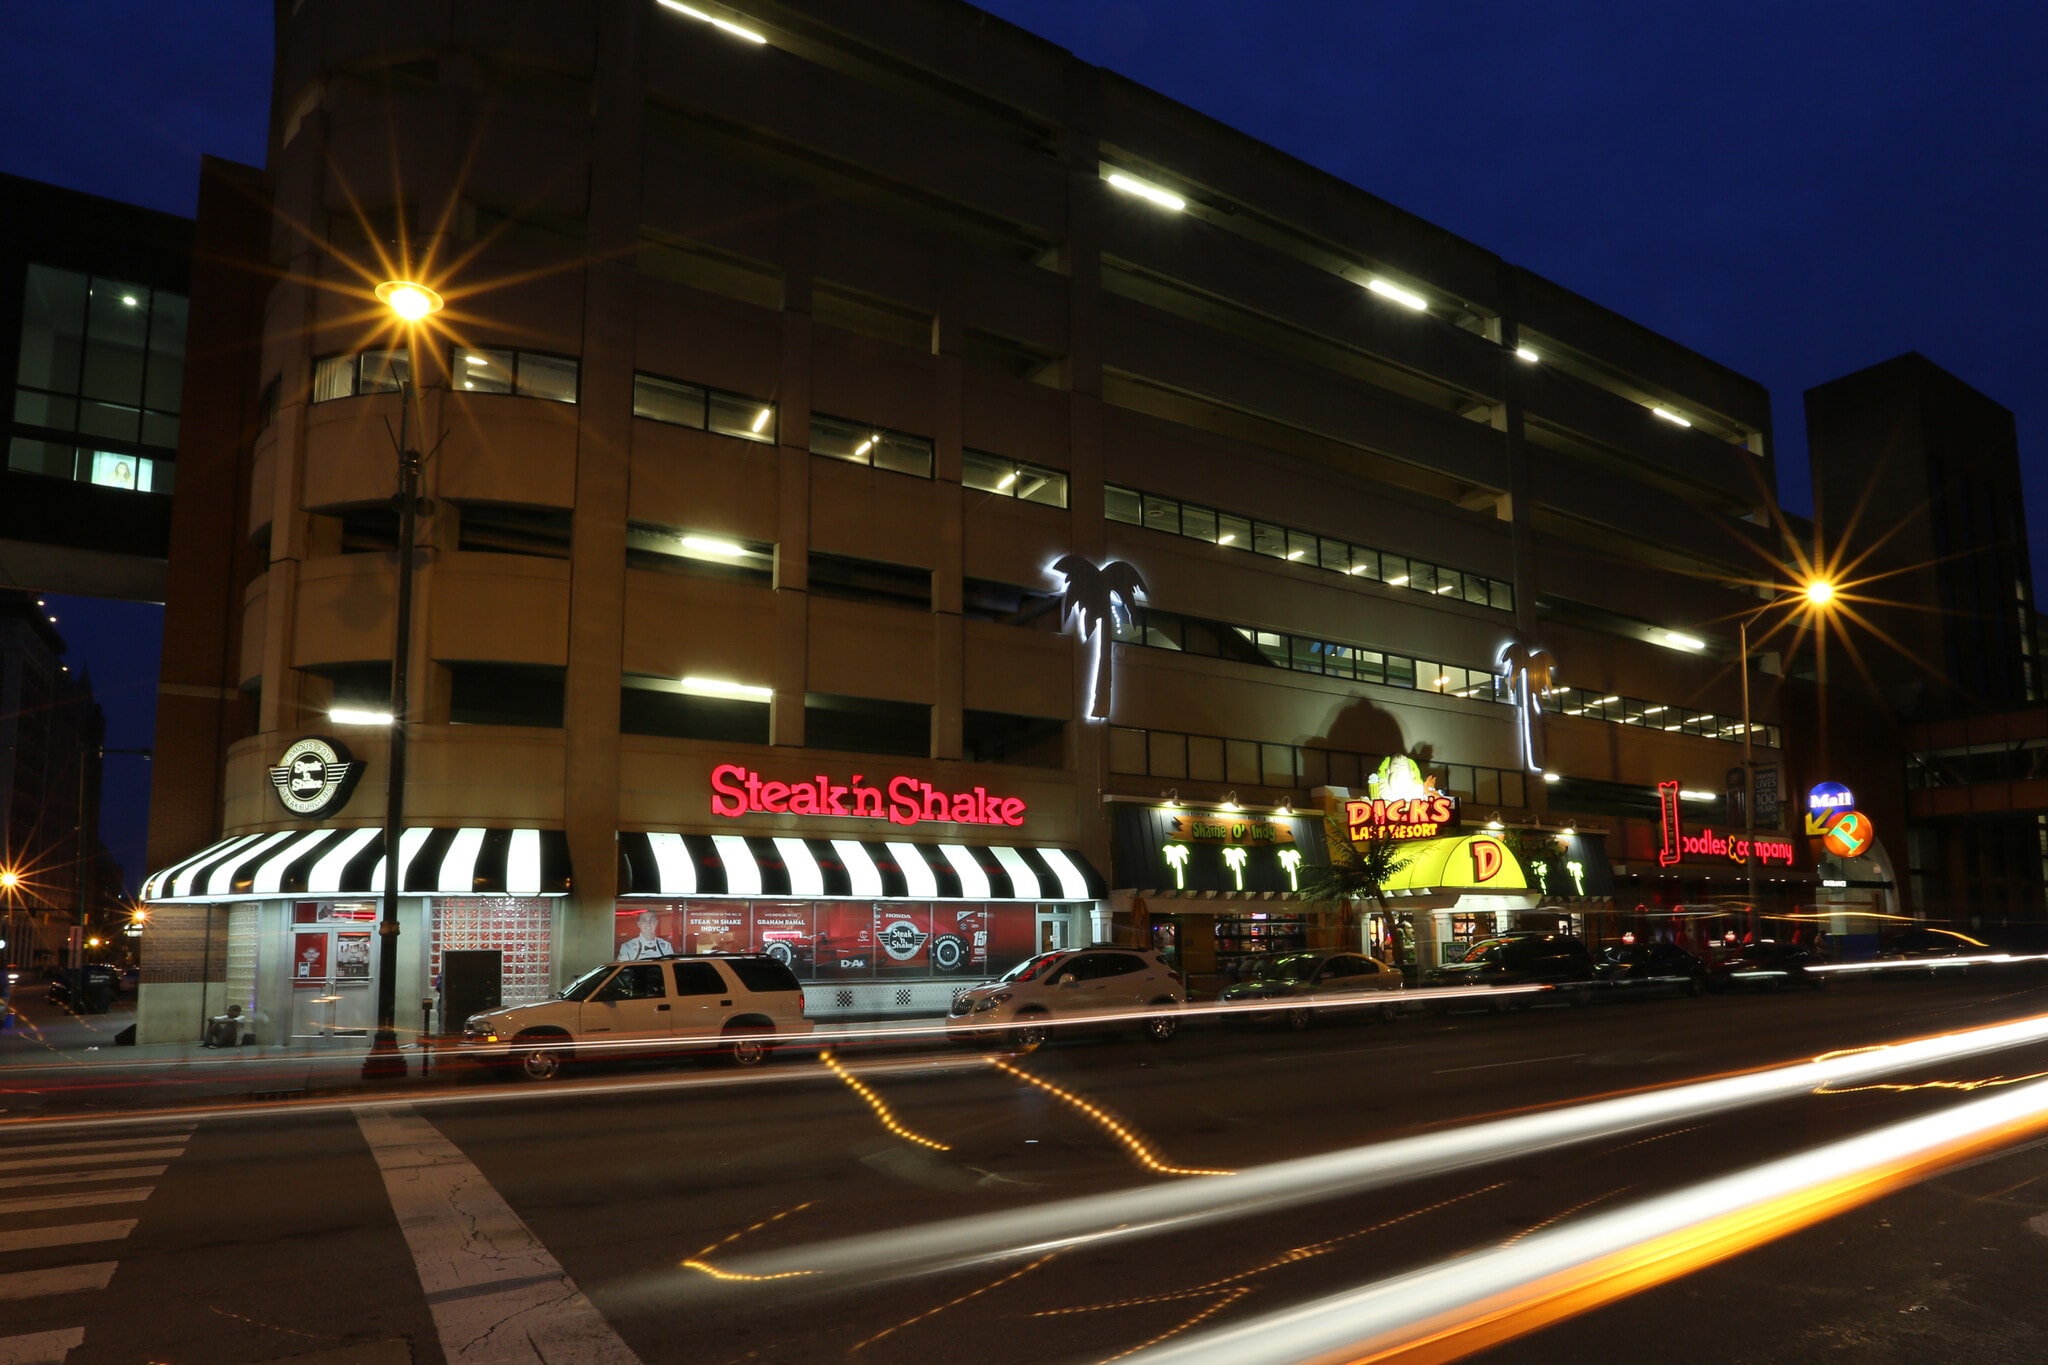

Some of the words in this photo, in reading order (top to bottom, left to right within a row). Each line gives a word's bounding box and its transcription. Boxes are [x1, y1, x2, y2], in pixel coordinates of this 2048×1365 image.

[286, 742, 314, 762] FAMOUS
[1756, 779, 1776, 789] LIVES
[281, 787, 333, 811] STEAKBURGERS
[711, 764, 848, 818] Steak
[888, 776, 1026, 826] Shake
[1756, 793, 1777, 805] 100
[1810, 792, 1851, 808] Mall
[1346, 796, 1451, 826] DICK'S
[1192, 821, 1227, 839] Shame
[1250, 823, 1276, 842] Indy
[1828, 813, 1864, 855] P
[1681, 829, 1727, 856] oodles
[1470, 840, 1502, 883] D
[892, 929, 912, 938] Steak
[891, 941, 914, 949] Shake
